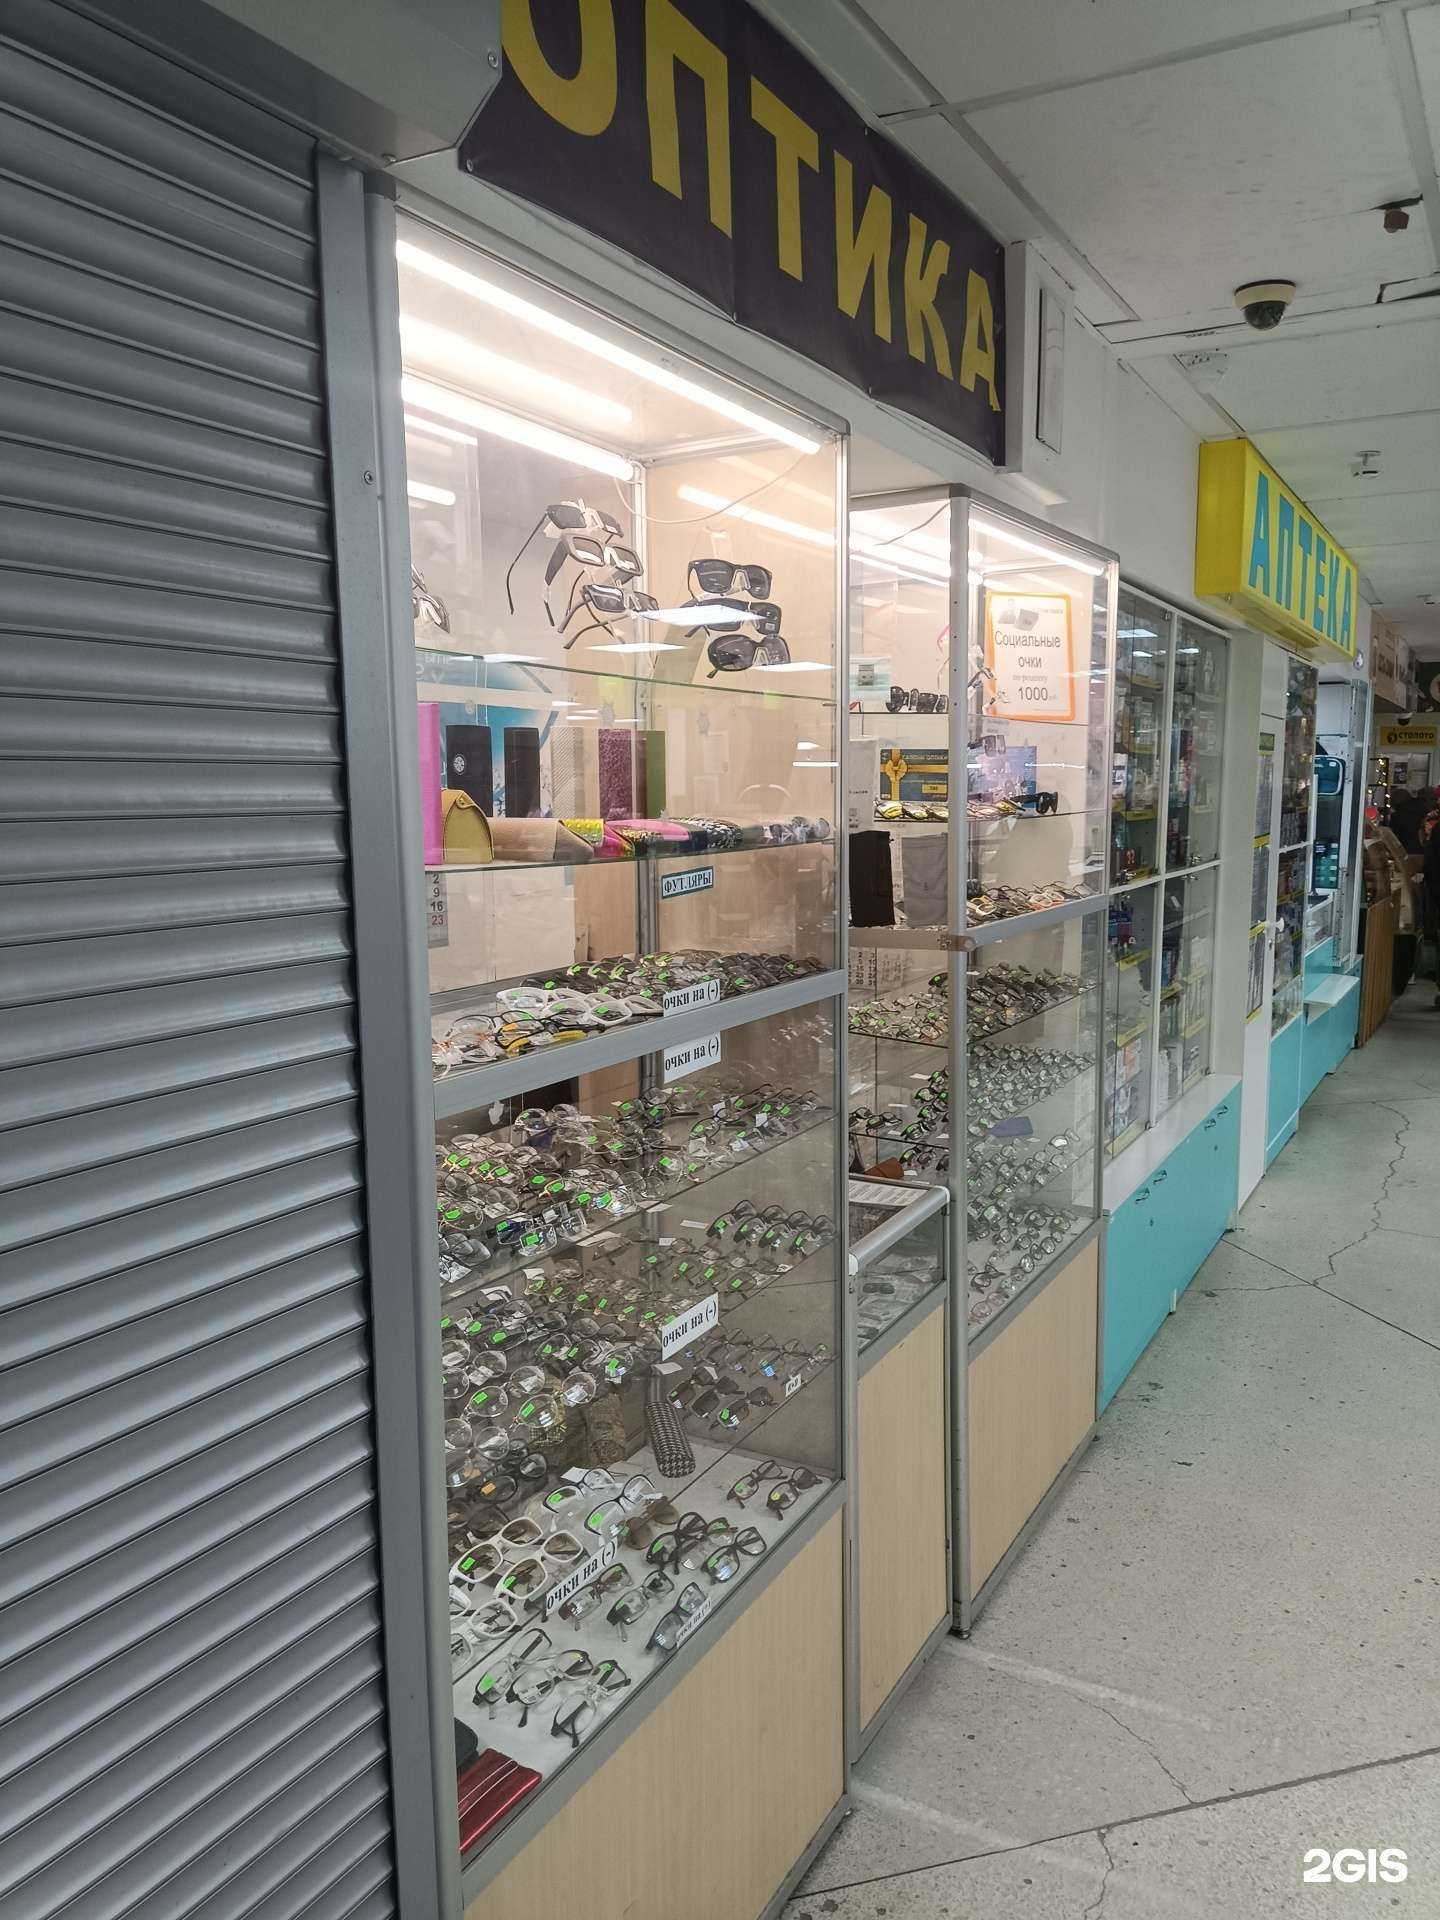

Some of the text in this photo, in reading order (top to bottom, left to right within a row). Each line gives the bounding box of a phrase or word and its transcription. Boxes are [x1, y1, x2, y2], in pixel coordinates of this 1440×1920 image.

[1248, 470, 1351, 651] АПТЕКА
[995, 631, 1061, 648] Социальные
[1018, 656, 1042, 668] очки
[1018, 687, 1048, 701] 1000
[433, 874, 440, 884] 2
[664, 872, 713, 893] ФУТЛЯРЫ
[433, 888, 440, 898] 9
[431, 901, 444, 911] 16
[431, 914, 444, 926] 23
[664, 981, 719, 1010] очки на (-)
[665, 1036, 719, 1071] очки на (-)
[663, 1299, 717, 1348] очки на (-)
[547, 1540, 616, 1610] очки на (-)
